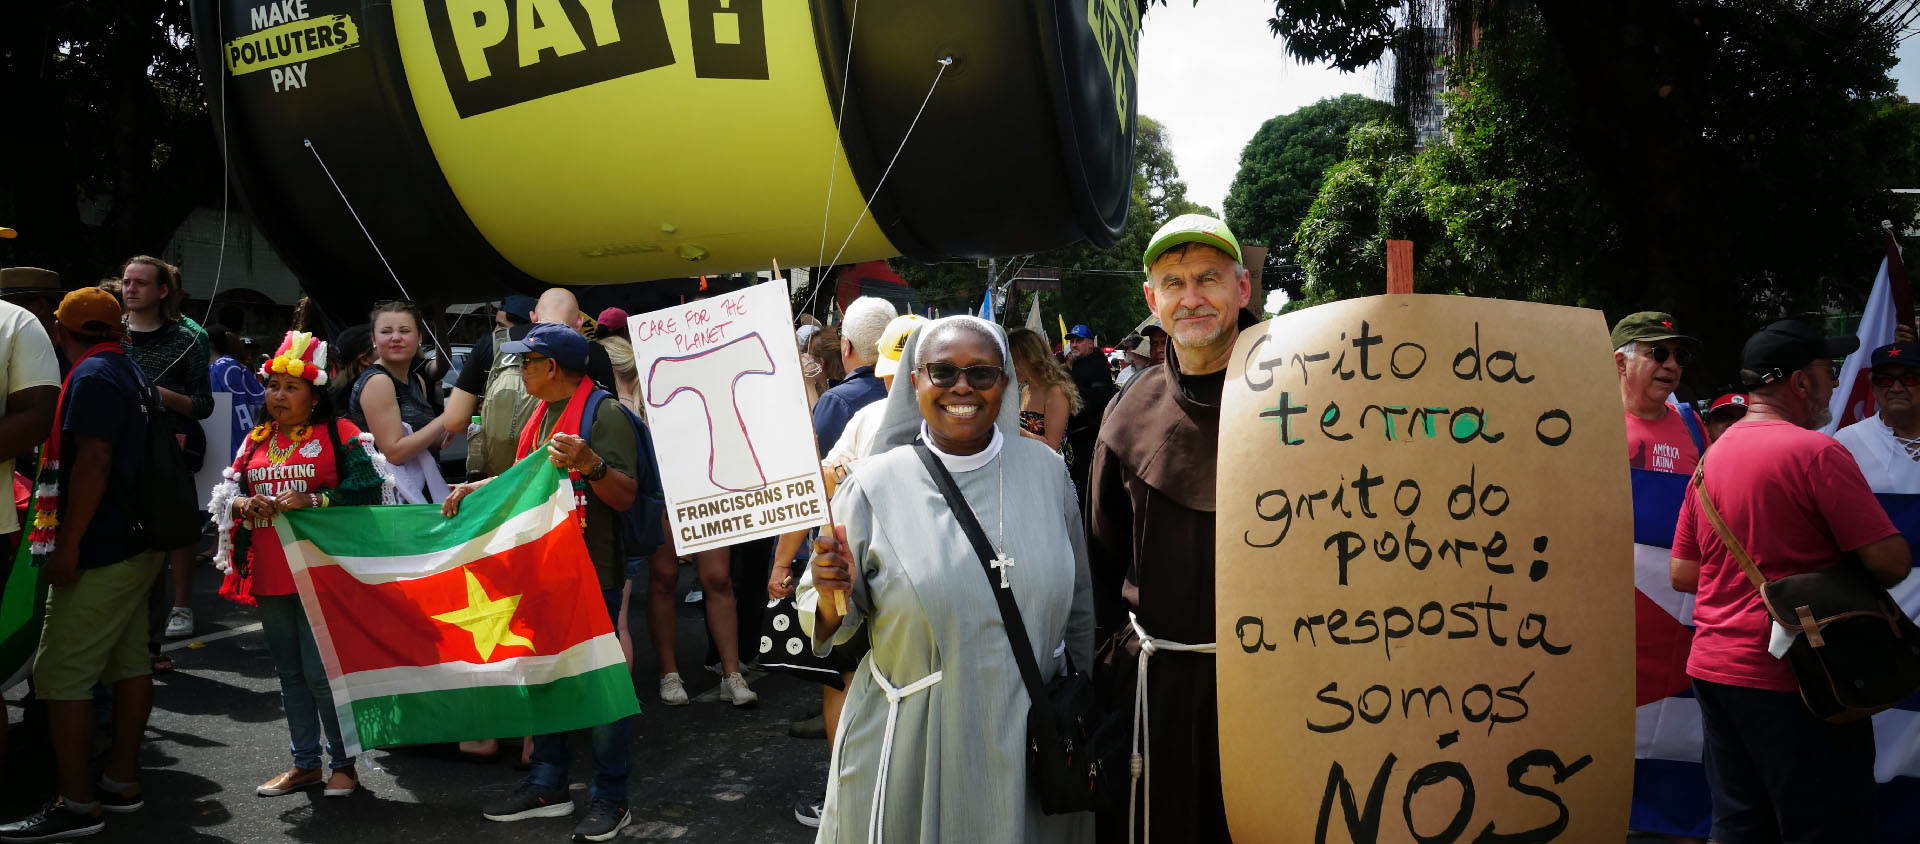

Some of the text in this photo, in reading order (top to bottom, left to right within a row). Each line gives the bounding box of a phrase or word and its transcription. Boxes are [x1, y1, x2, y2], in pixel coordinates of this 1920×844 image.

[251, 0, 310, 31] MAKE
[231, 22, 348, 68] POLLUTERS
[270, 62, 308, 93] PAY
[638, 295, 747, 342] CARE FOR THE
[674, 320, 734, 352] PLANET
[1244, 320, 1535, 392] Grito da
[1259, 391, 1572, 446] terra o
[247, 463, 316, 483] PROTECTING
[1652, 456, 1674, 470] LATINA
[254, 479, 308, 496] OUR LAND
[676, 479, 816, 523] FRANCISCANS FOR
[1244, 462, 1510, 548] grito do
[680, 498, 821, 542] CLIMATE JUSTICE
[1235, 585, 1572, 661] a resposta
[1306, 670, 1536, 736] somos
